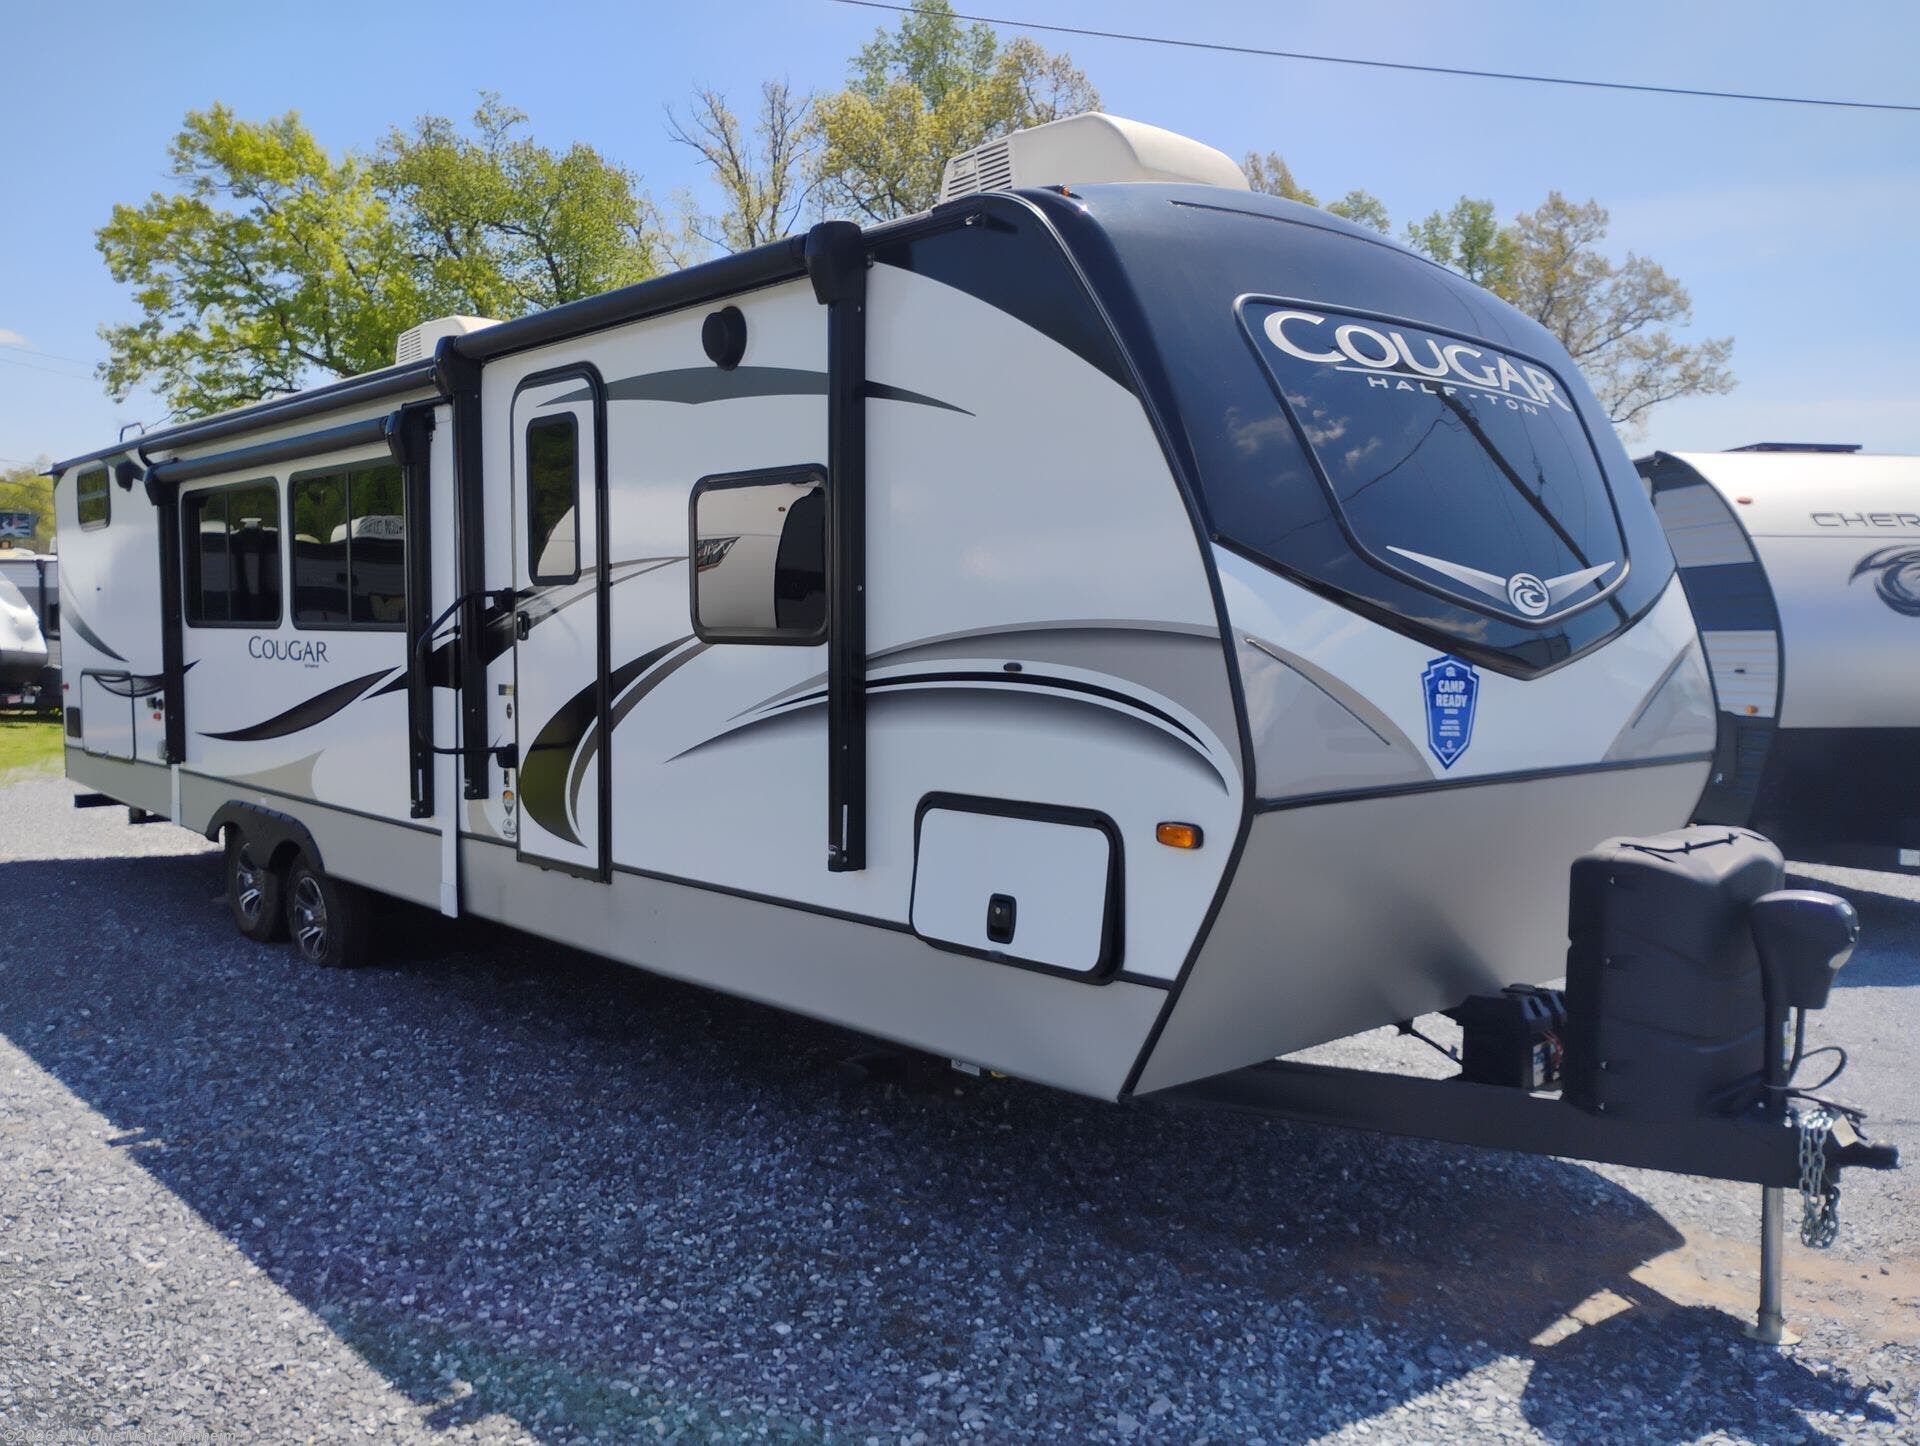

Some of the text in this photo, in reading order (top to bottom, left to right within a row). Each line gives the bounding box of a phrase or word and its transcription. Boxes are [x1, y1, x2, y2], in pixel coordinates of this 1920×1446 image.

[1264, 310, 1571, 411] COUGAR
[1366, 376, 1539, 415] HALF-TON
[1811, 512, 1920, 527] CHER
[248, 635, 329, 663] COUGAR
[1438, 680, 1466, 693] CAMP
[1436, 694, 1468, 707] READY
